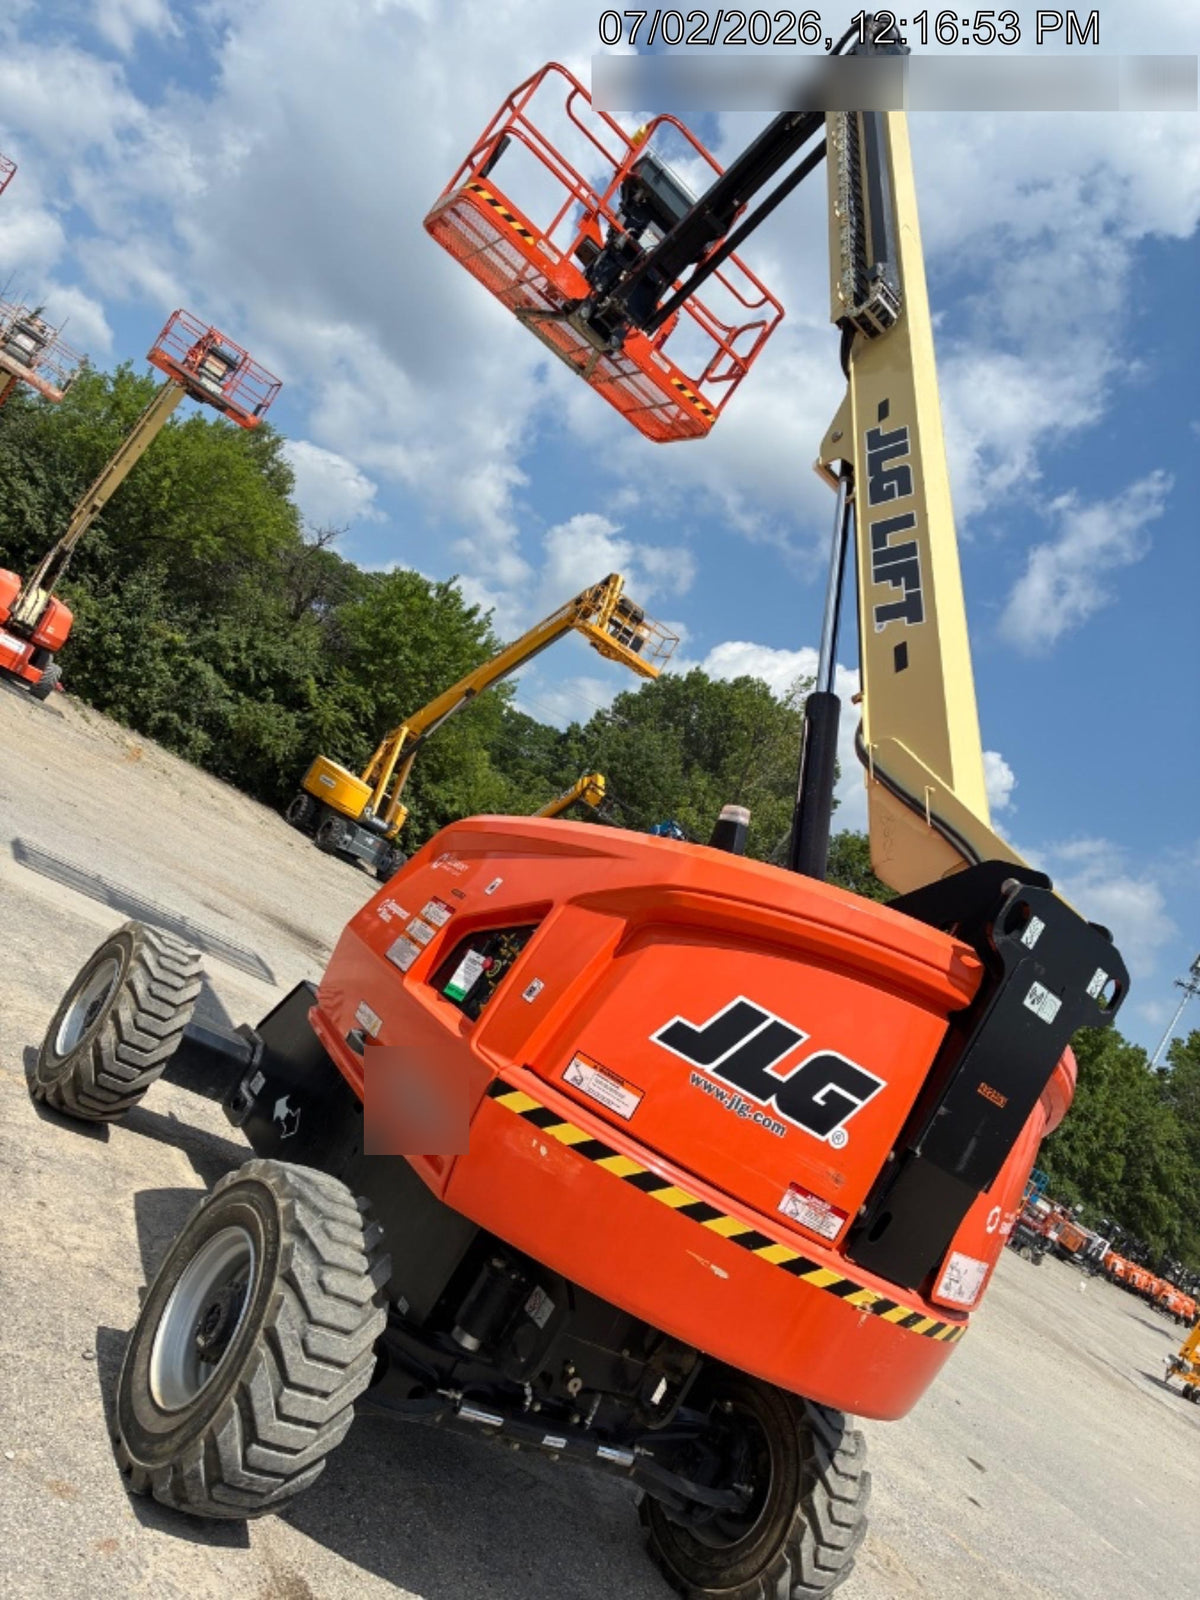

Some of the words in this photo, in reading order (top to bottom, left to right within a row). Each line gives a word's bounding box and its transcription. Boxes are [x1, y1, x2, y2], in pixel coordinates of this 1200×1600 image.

[866, 424, 915, 508] JLG
[868, 511, 925, 625] LIFT
[649, 995, 888, 1142] JLG
[689, 1071, 787, 1138] www.jlg.com
